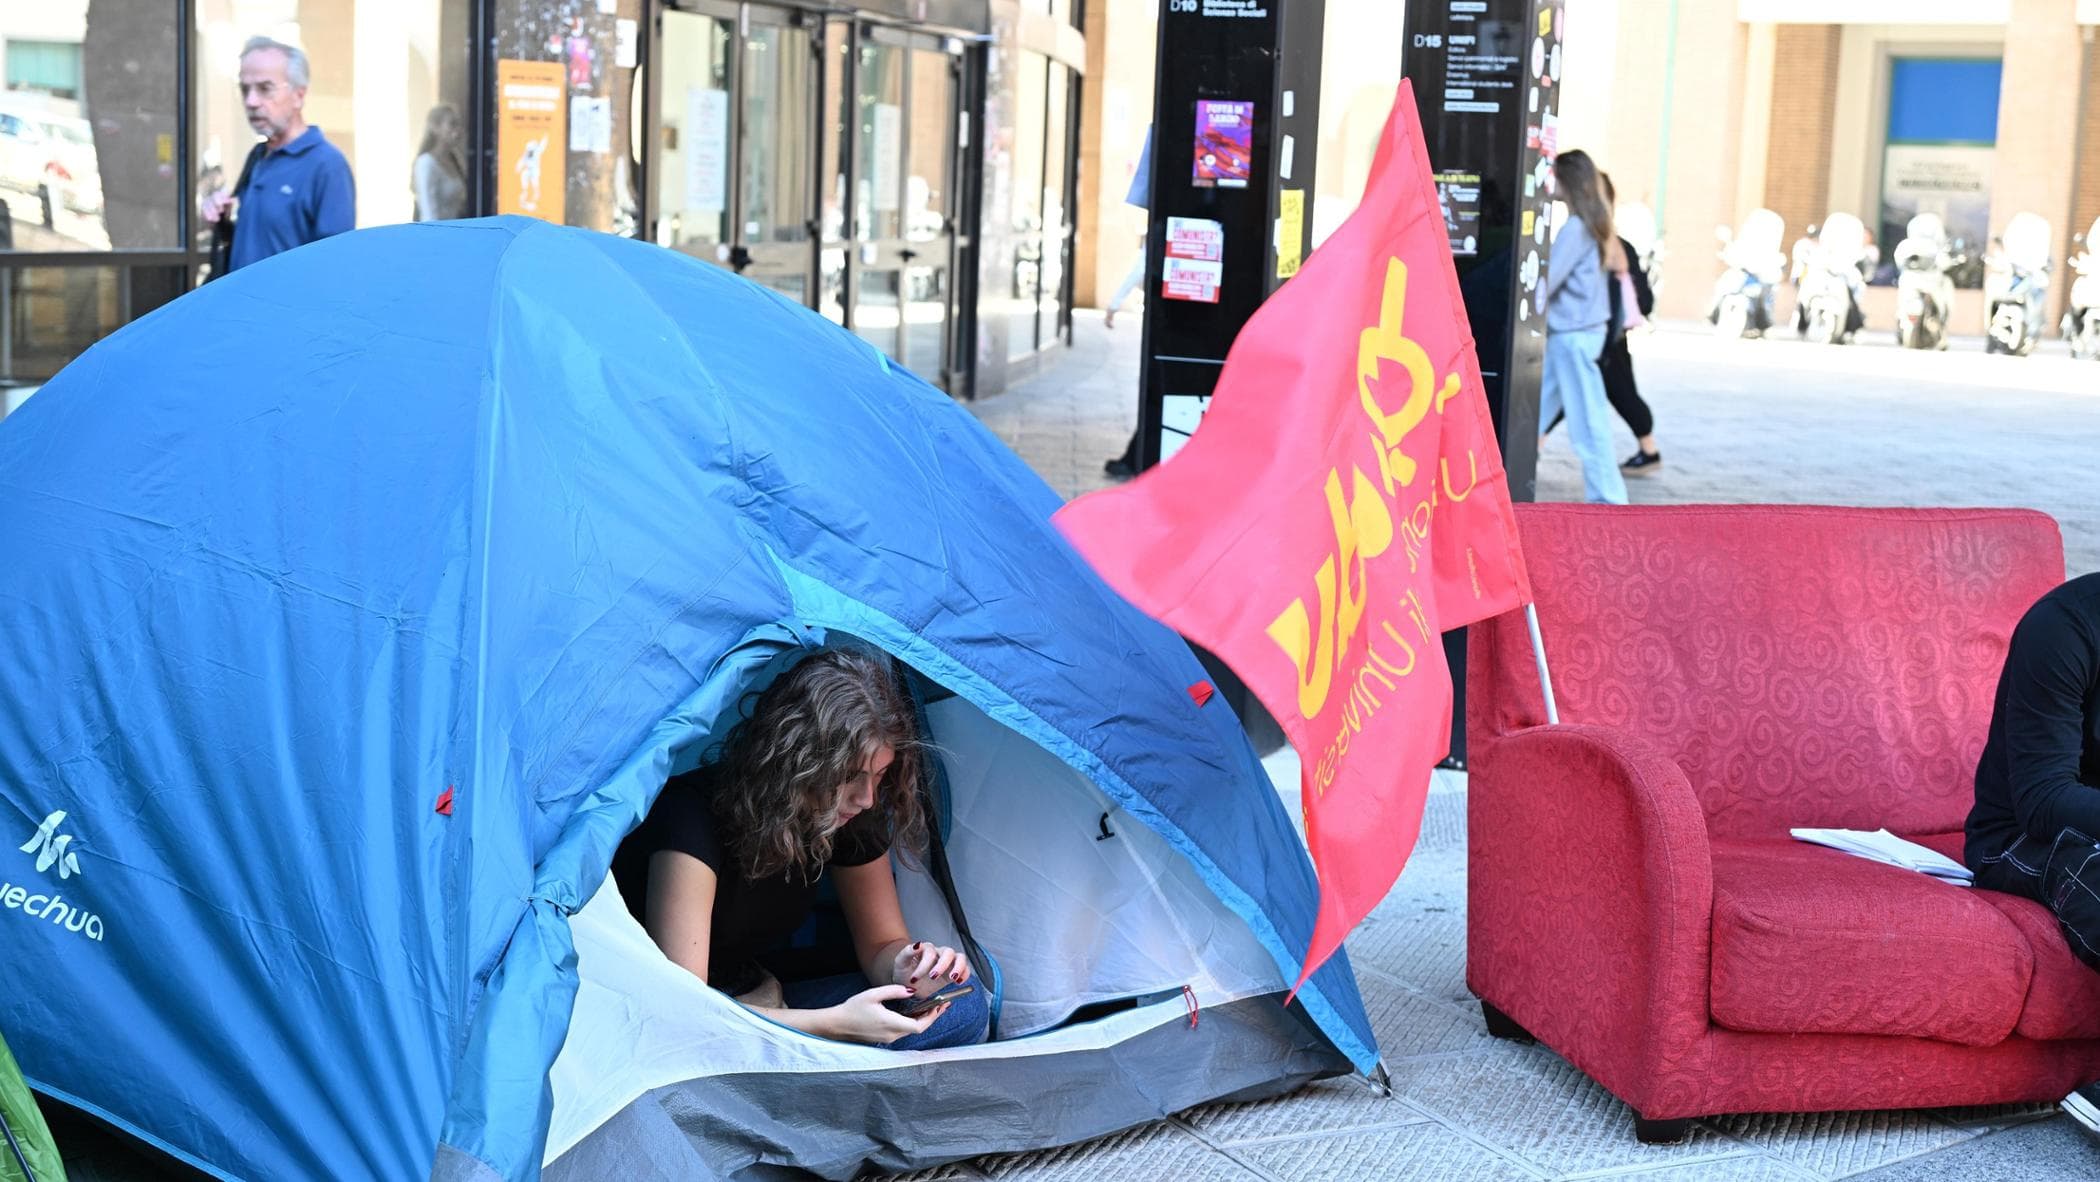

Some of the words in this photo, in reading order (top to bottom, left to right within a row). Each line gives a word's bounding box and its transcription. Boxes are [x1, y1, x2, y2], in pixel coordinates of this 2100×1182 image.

[1170, 0, 1198, 12] D10
[1238, 9, 1267, 17] Sociali
[1414, 34, 1442, 48] D15
